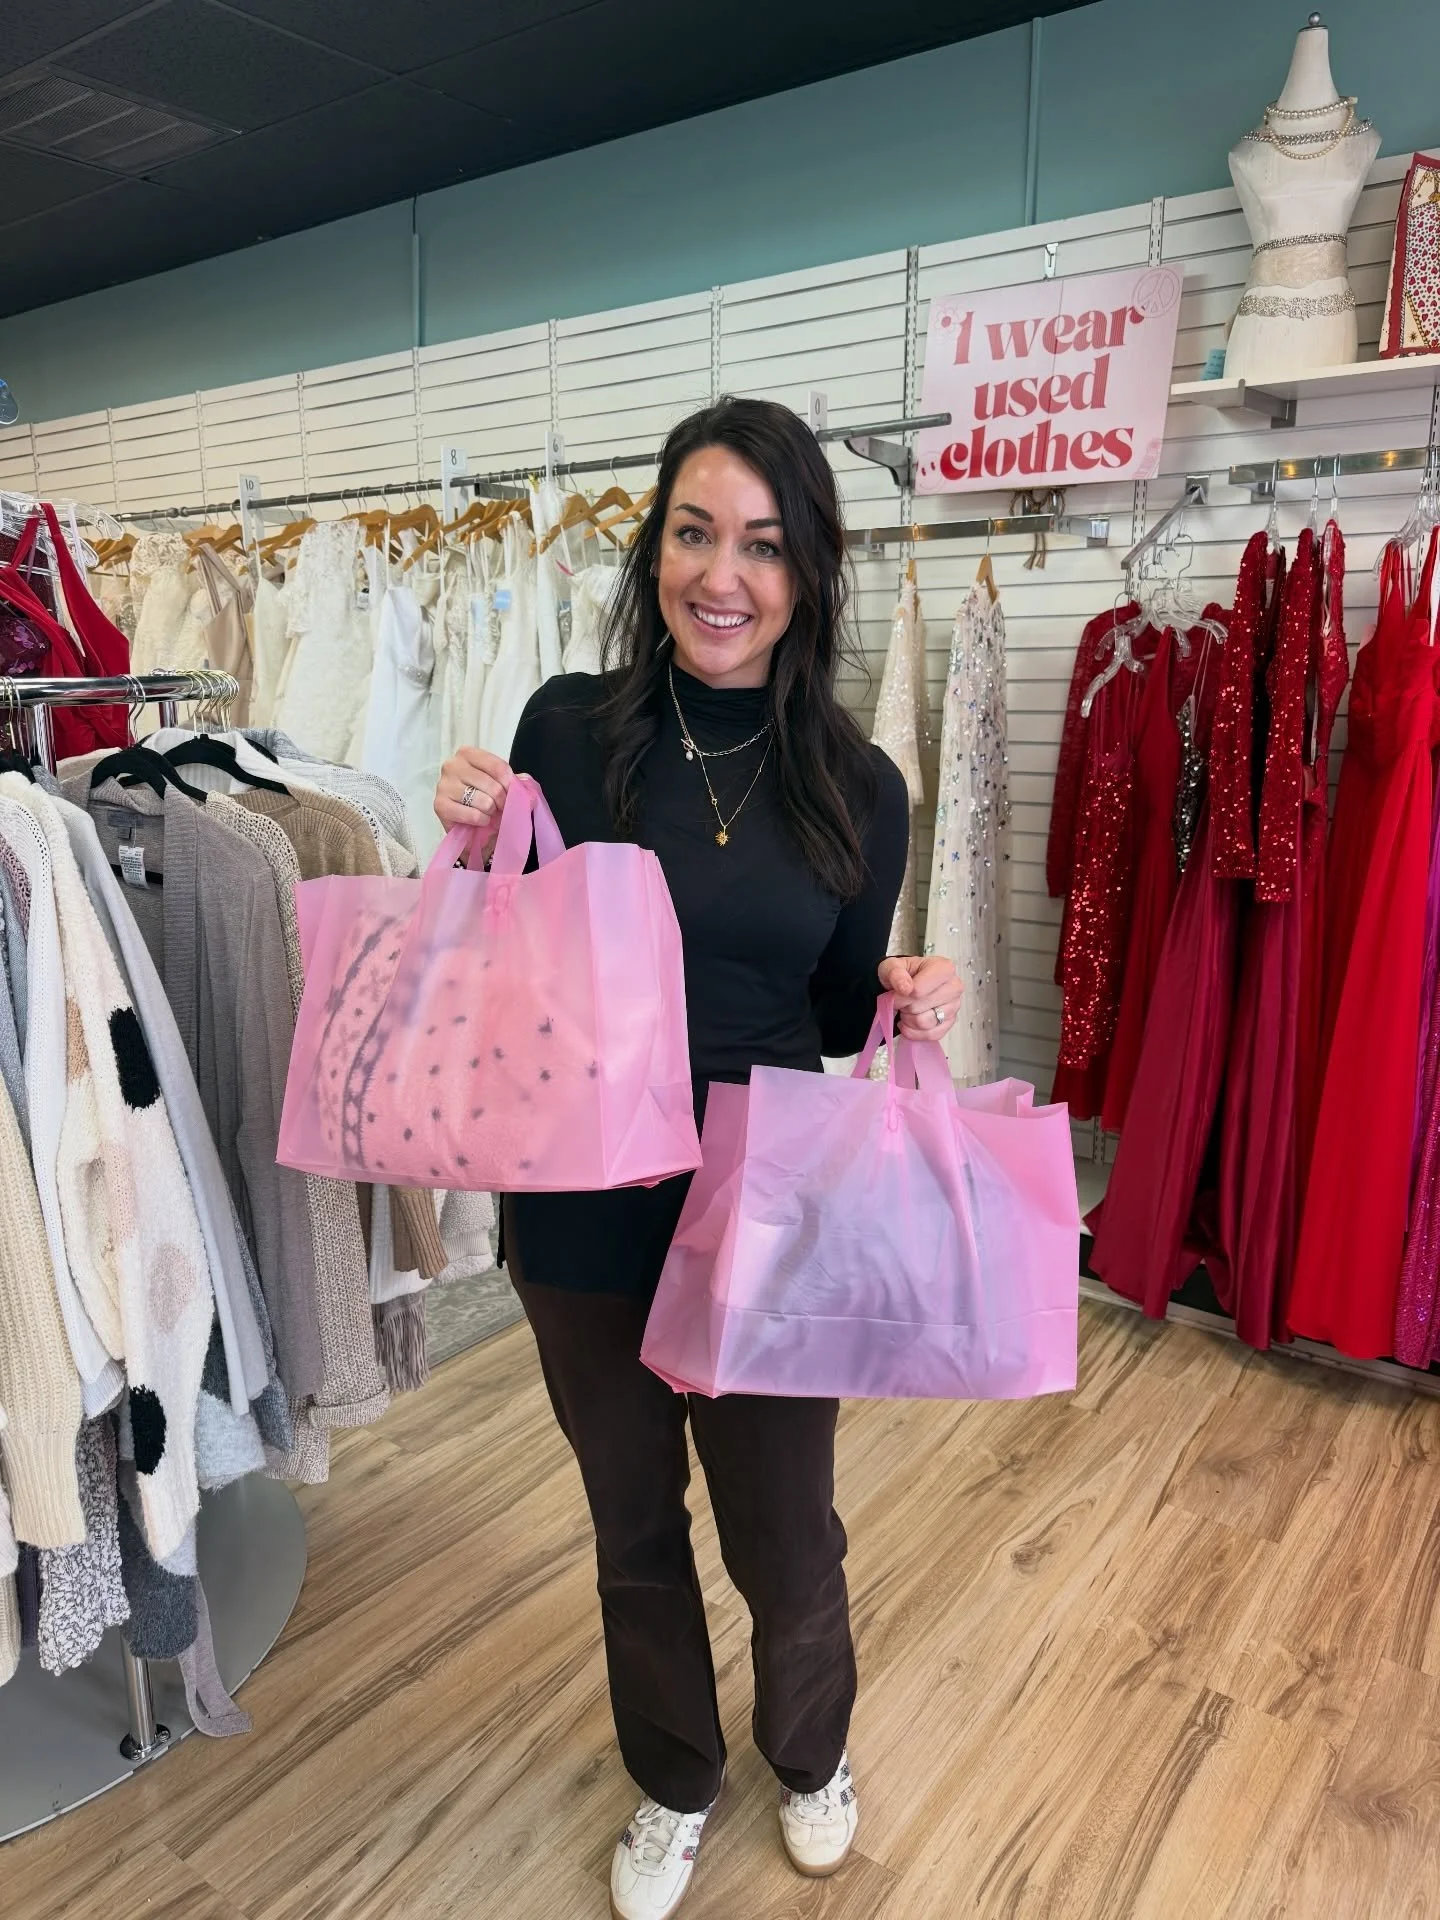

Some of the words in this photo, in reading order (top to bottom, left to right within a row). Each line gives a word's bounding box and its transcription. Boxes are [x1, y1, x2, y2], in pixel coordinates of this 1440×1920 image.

[941, 311, 975, 365] I
[984, 305, 1145, 361] wear
[974, 353, 1111, 420] used
[450, 448, 457, 466] 8
[552, 437, 559, 453] 6
[939, 420, 1135, 481] clothes
[244, 478, 255, 491] 10
